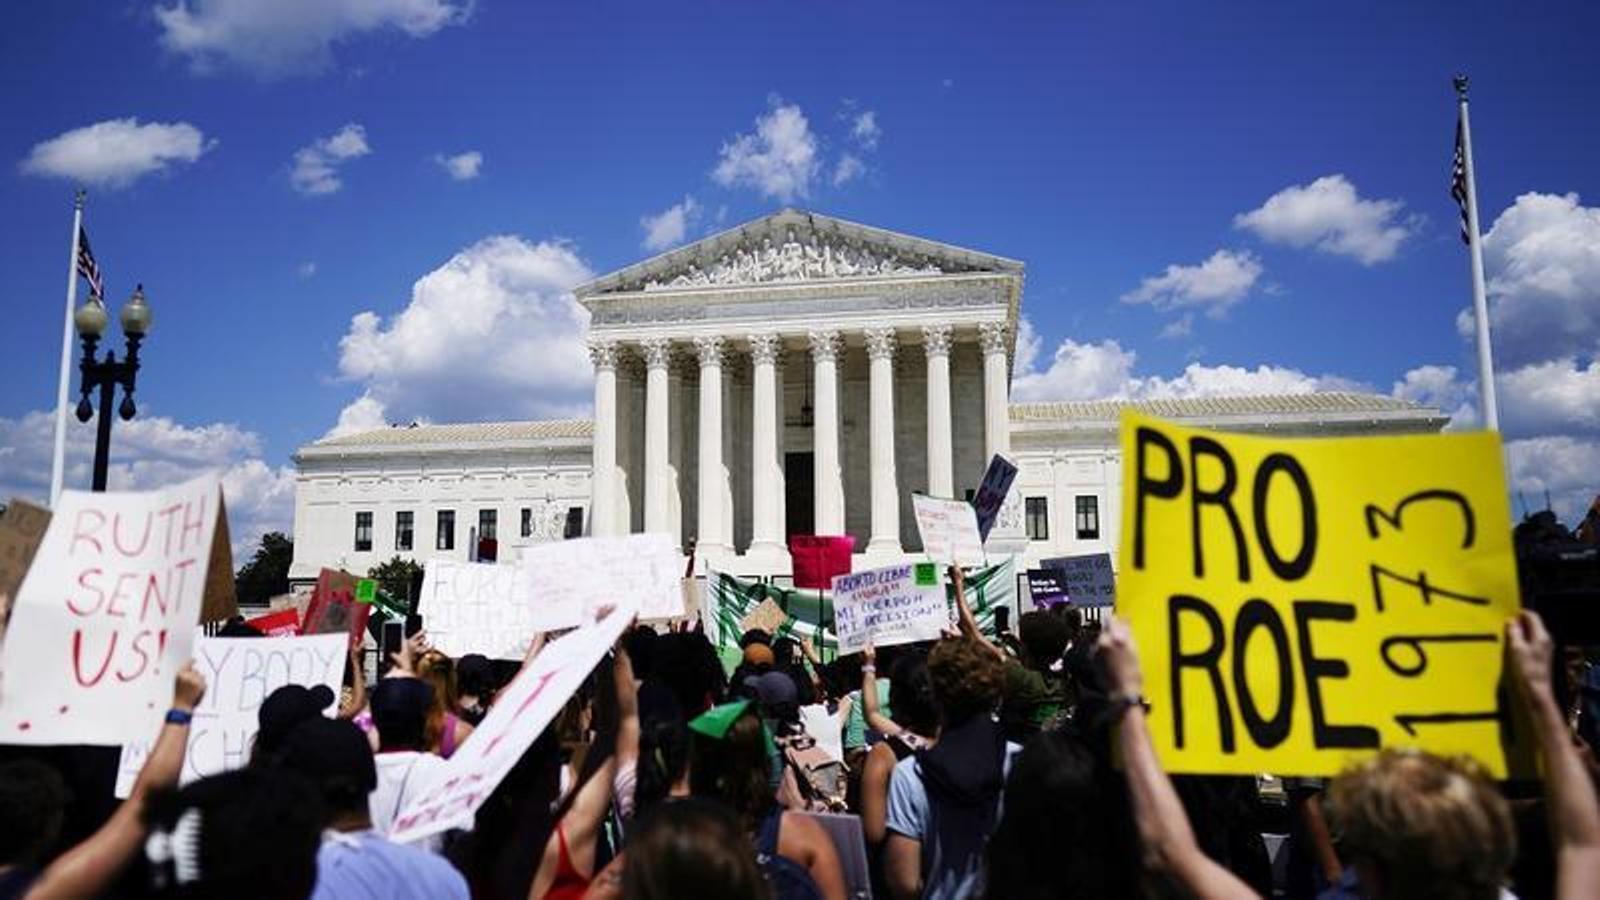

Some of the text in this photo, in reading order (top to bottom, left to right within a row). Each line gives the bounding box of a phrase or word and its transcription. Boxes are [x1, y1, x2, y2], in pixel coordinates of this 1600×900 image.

[69, 496, 207, 557] RUTH
[1132, 425, 1319, 583] PRO
[66, 559, 196, 624] SENT
[1364, 489, 1499, 738] 1973
[71, 629, 169, 688] US!
[1168, 594, 1381, 755] ROE
